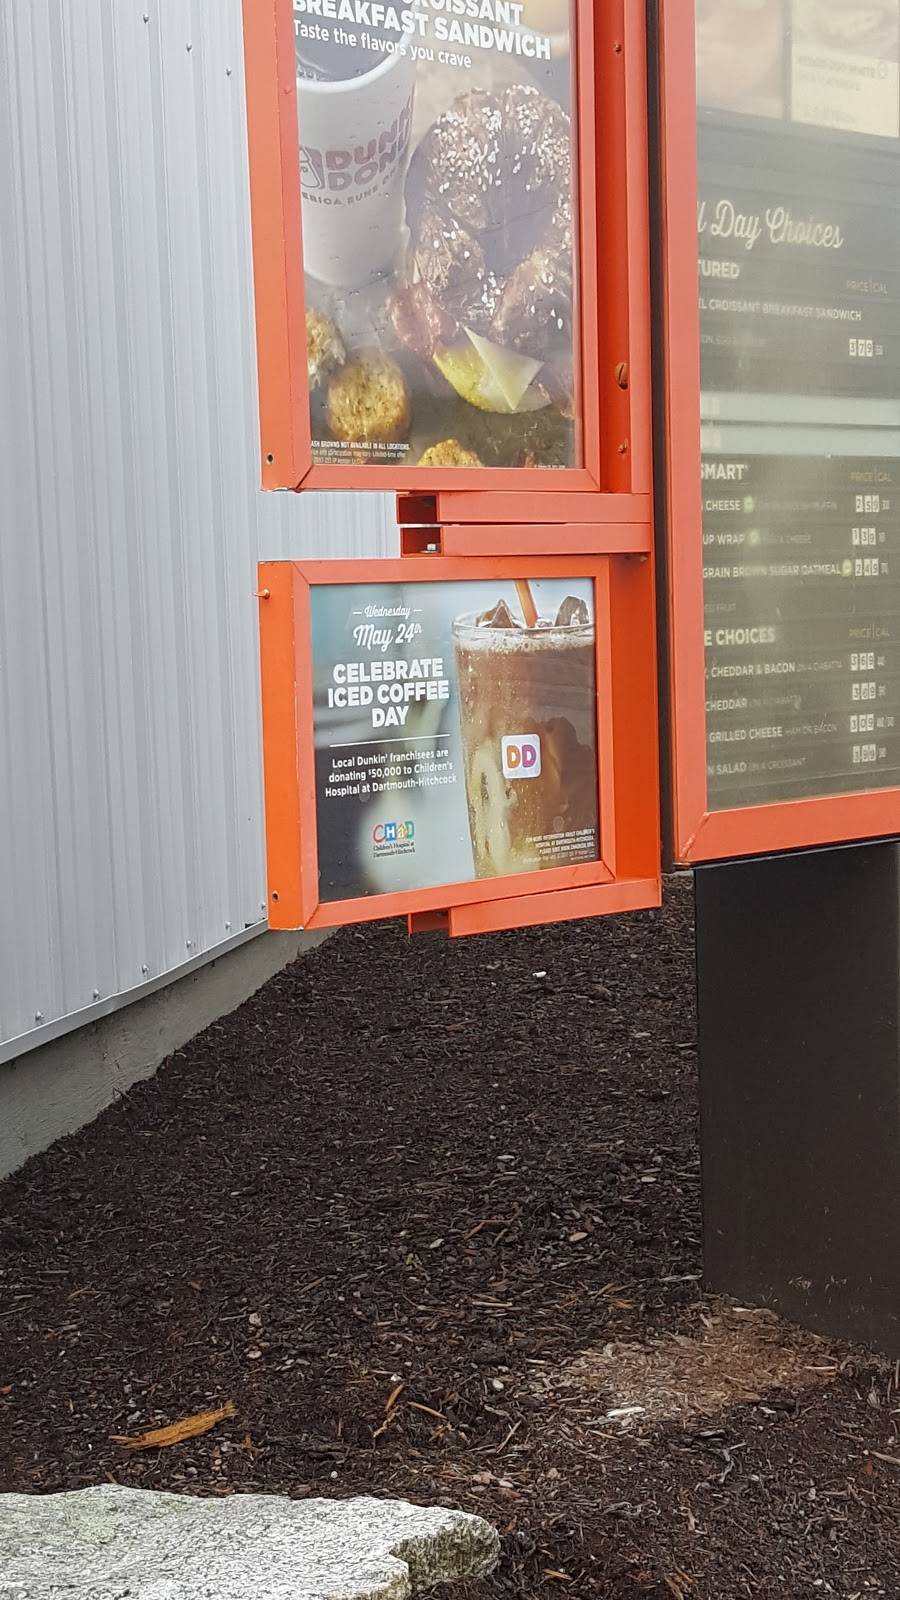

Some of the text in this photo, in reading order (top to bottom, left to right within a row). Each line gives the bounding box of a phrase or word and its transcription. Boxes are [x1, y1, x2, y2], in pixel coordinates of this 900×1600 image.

[402, 0, 523, 25] ISSANT
[294, 20, 472, 68] Taste the flavors you crave
[434, 17, 551, 60] SANDWICH
[711, 200, 762, 250] Day
[766, 207, 845, 248] Choices
[816, 307, 862, 321] SANDWICH
[705, 500, 741, 511] CHEESE
[717, 534, 745, 545] WRAP
[703, 563, 841, 578] GRAIN BROWN SUGAR OATMEAL
[364, 604, 411, 619] Wednesday
[353, 623, 422, 652] May 24th
[715, 627, 776, 646] CHOICES
[333, 658, 444, 684] CELEBRATE
[711, 665, 754, 678] CHEDDAR
[764, 662, 795, 674] BACON
[328, 680, 450, 708] ICED COFFEE
[705, 698, 748, 712] CHEDDAR
[372, 705, 409, 728] DAY
[709, 730, 746, 743] GRILLED
[749, 727, 783, 740] CHEESE
[332, 750, 449, 769] Local Dunkin' franchisees are
[506, 744, 537, 768] DD
[329, 761, 453, 783] donating $50,000 to Children's
[717, 762, 747, 775] SALAD
[325, 774, 457, 798] Hospital at Dartmouth-Hitchcock
